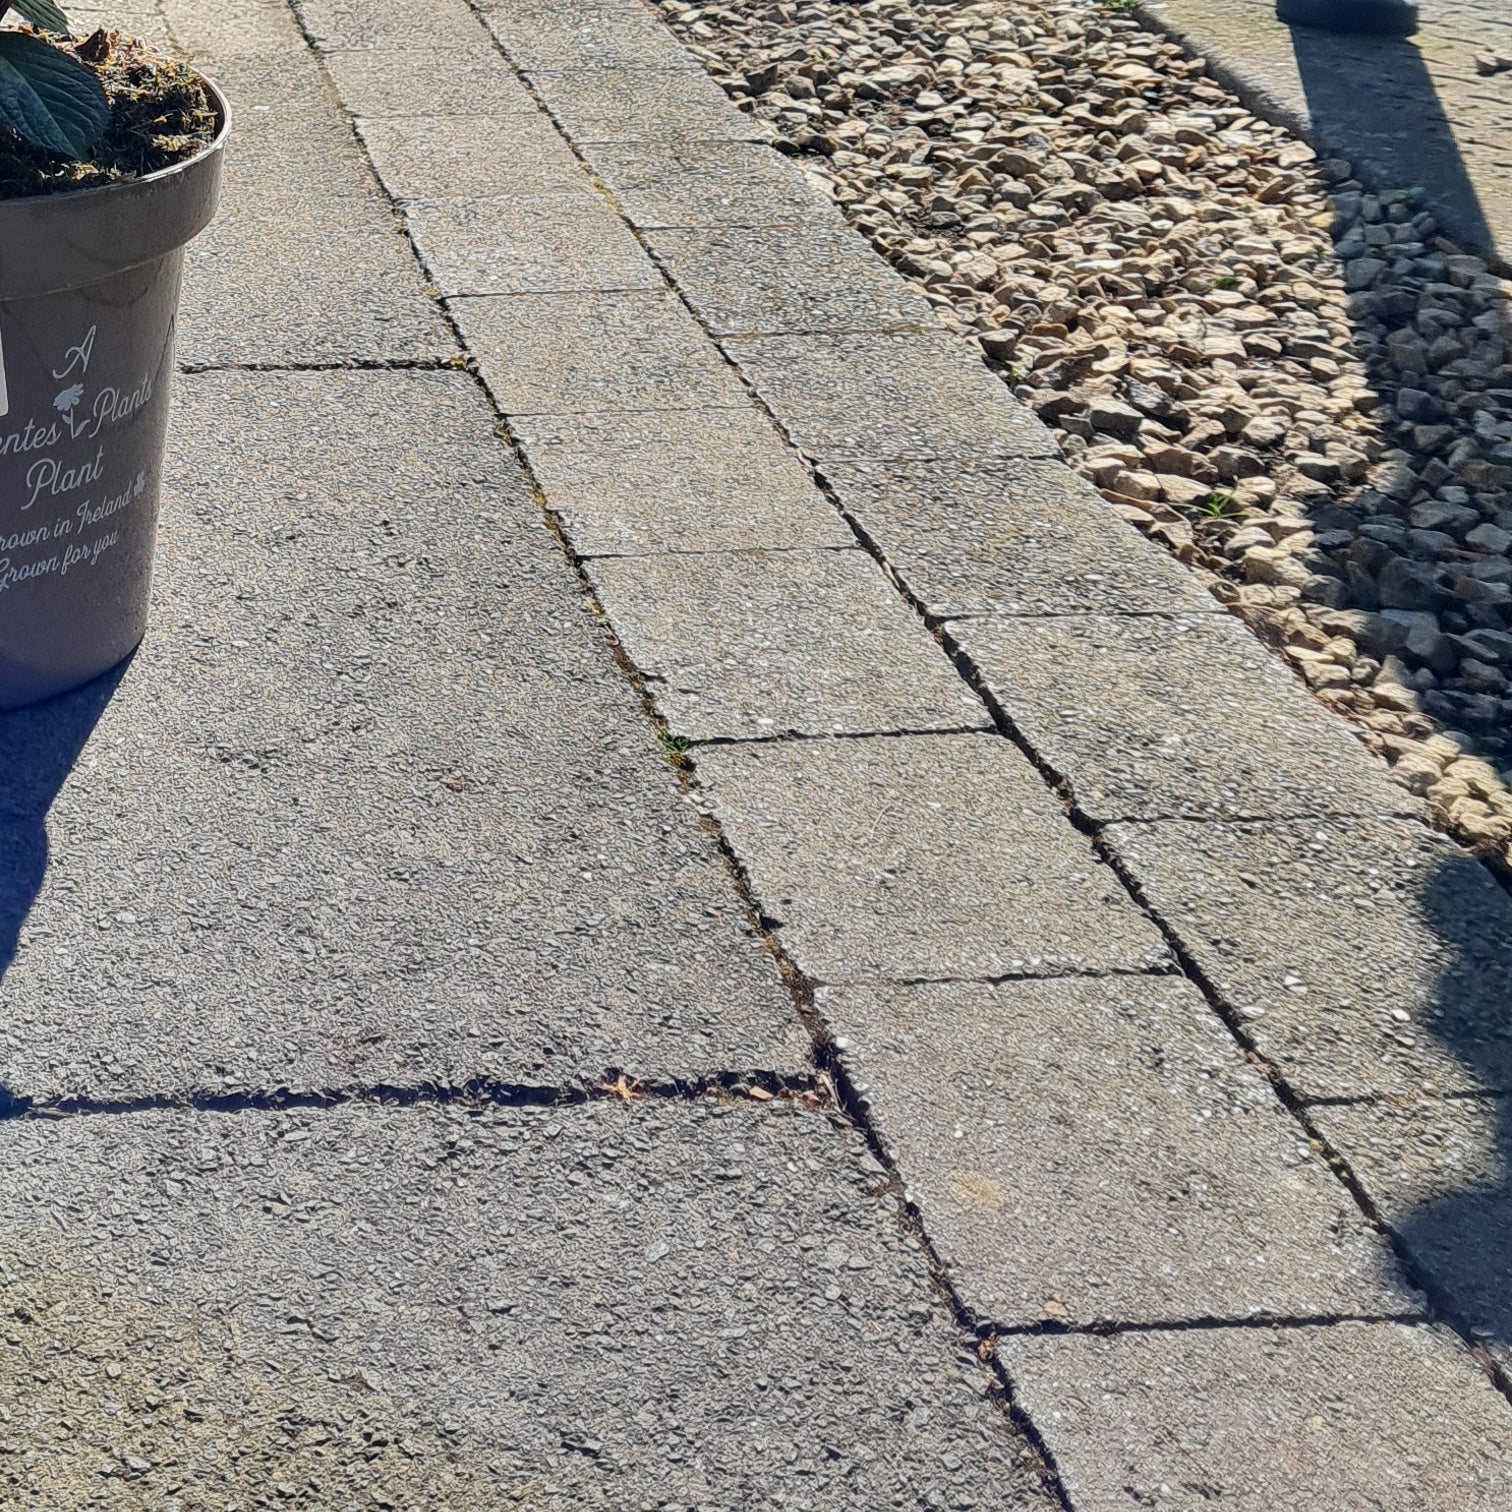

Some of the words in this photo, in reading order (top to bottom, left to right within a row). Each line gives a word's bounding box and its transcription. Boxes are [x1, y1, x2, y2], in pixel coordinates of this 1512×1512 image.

[52, 325, 96, 379] A
[21, 445, 104, 510] Plant
[53, 518, 73, 538] in
[76, 482, 133, 535] Ireland
[60, 543, 91, 576] for
[91, 529, 119, 566] you
